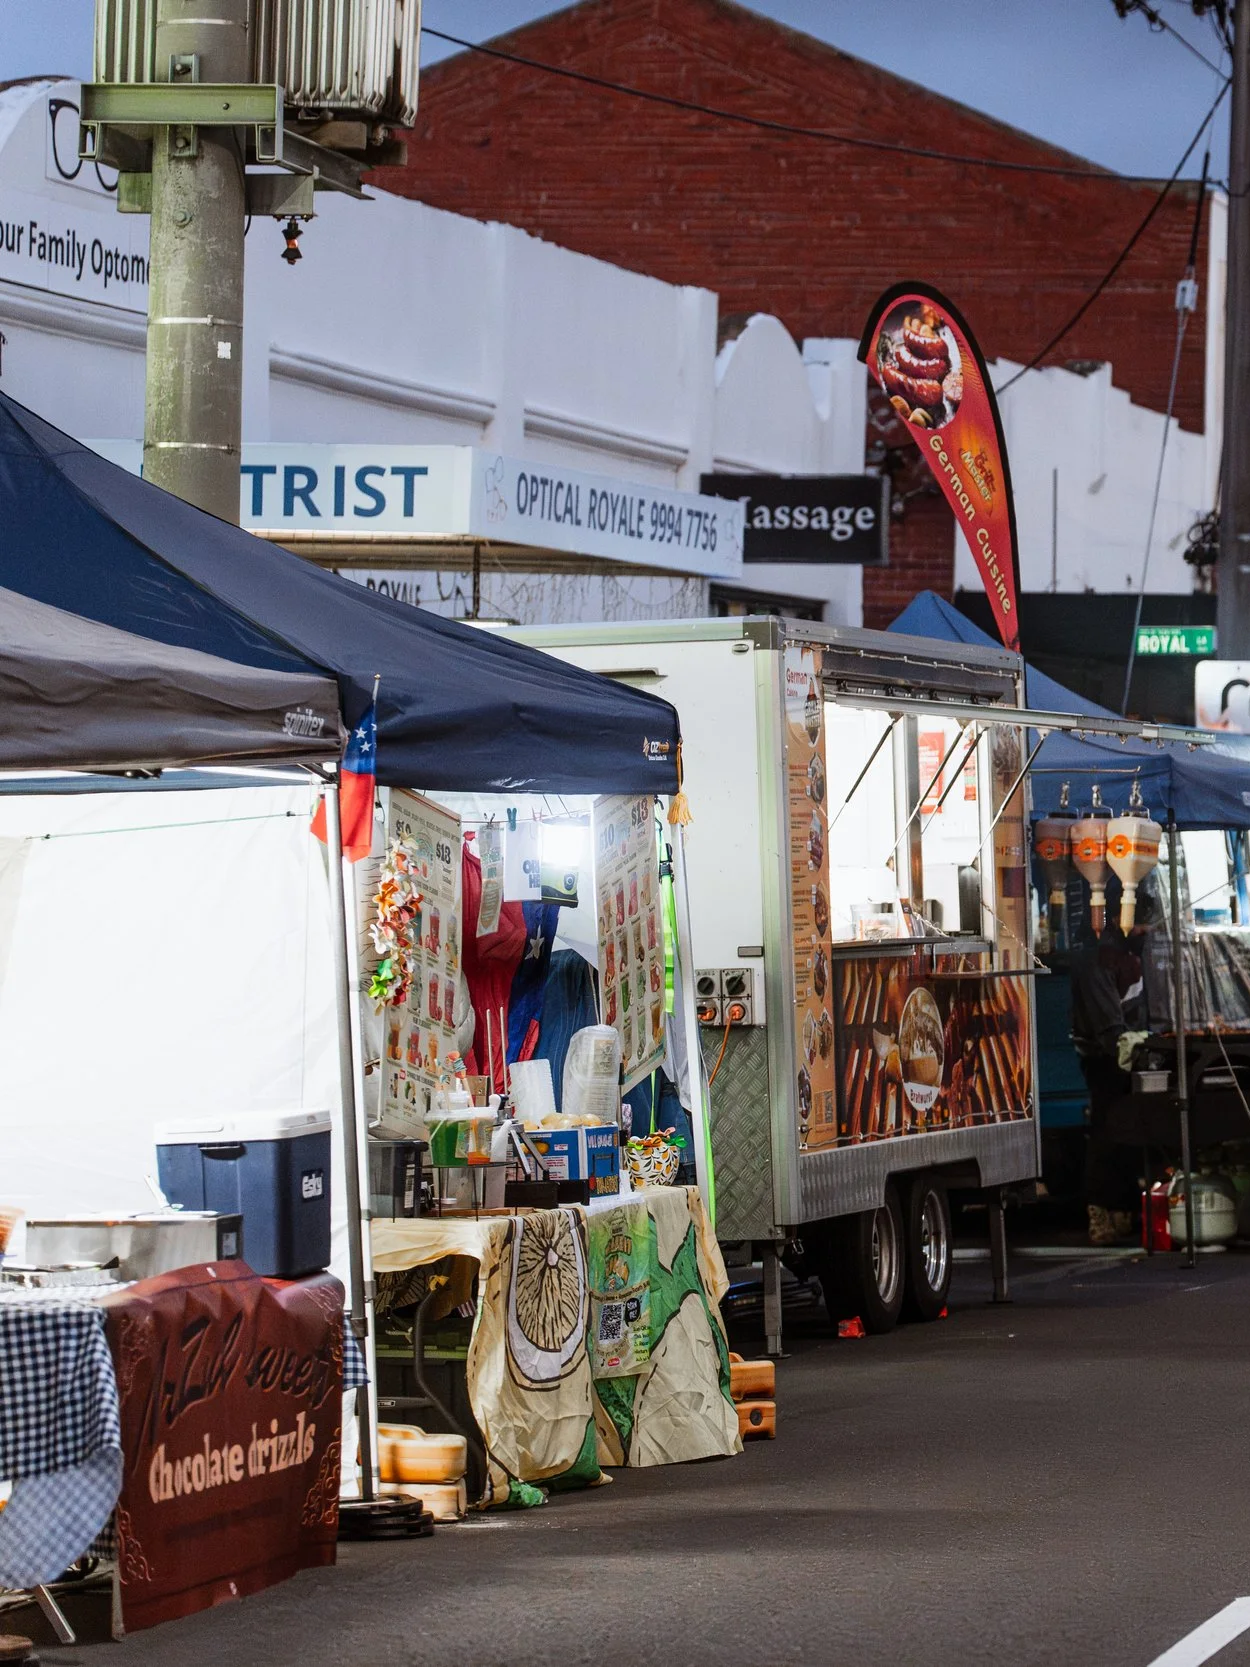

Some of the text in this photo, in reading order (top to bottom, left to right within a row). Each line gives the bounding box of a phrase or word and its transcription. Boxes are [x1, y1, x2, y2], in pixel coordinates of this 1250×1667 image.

[29, 220, 86, 281] Family
[91, 238, 150, 289] Optom
[240, 465, 429, 518] TRIST
[960, 451, 992, 501] Master
[516, 471, 718, 552] OPTICAL ROYALE 9994 7756
[744, 504, 876, 542] assage
[929, 434, 1012, 614] German Cuisine
[1138, 634, 1190, 654] ROYAL
[630, 797, 649, 827] $13
[435, 841, 451, 865] $13
[302, 1173, 323, 1199] Esky
[149, 1432, 245, 1504] Chocolate
